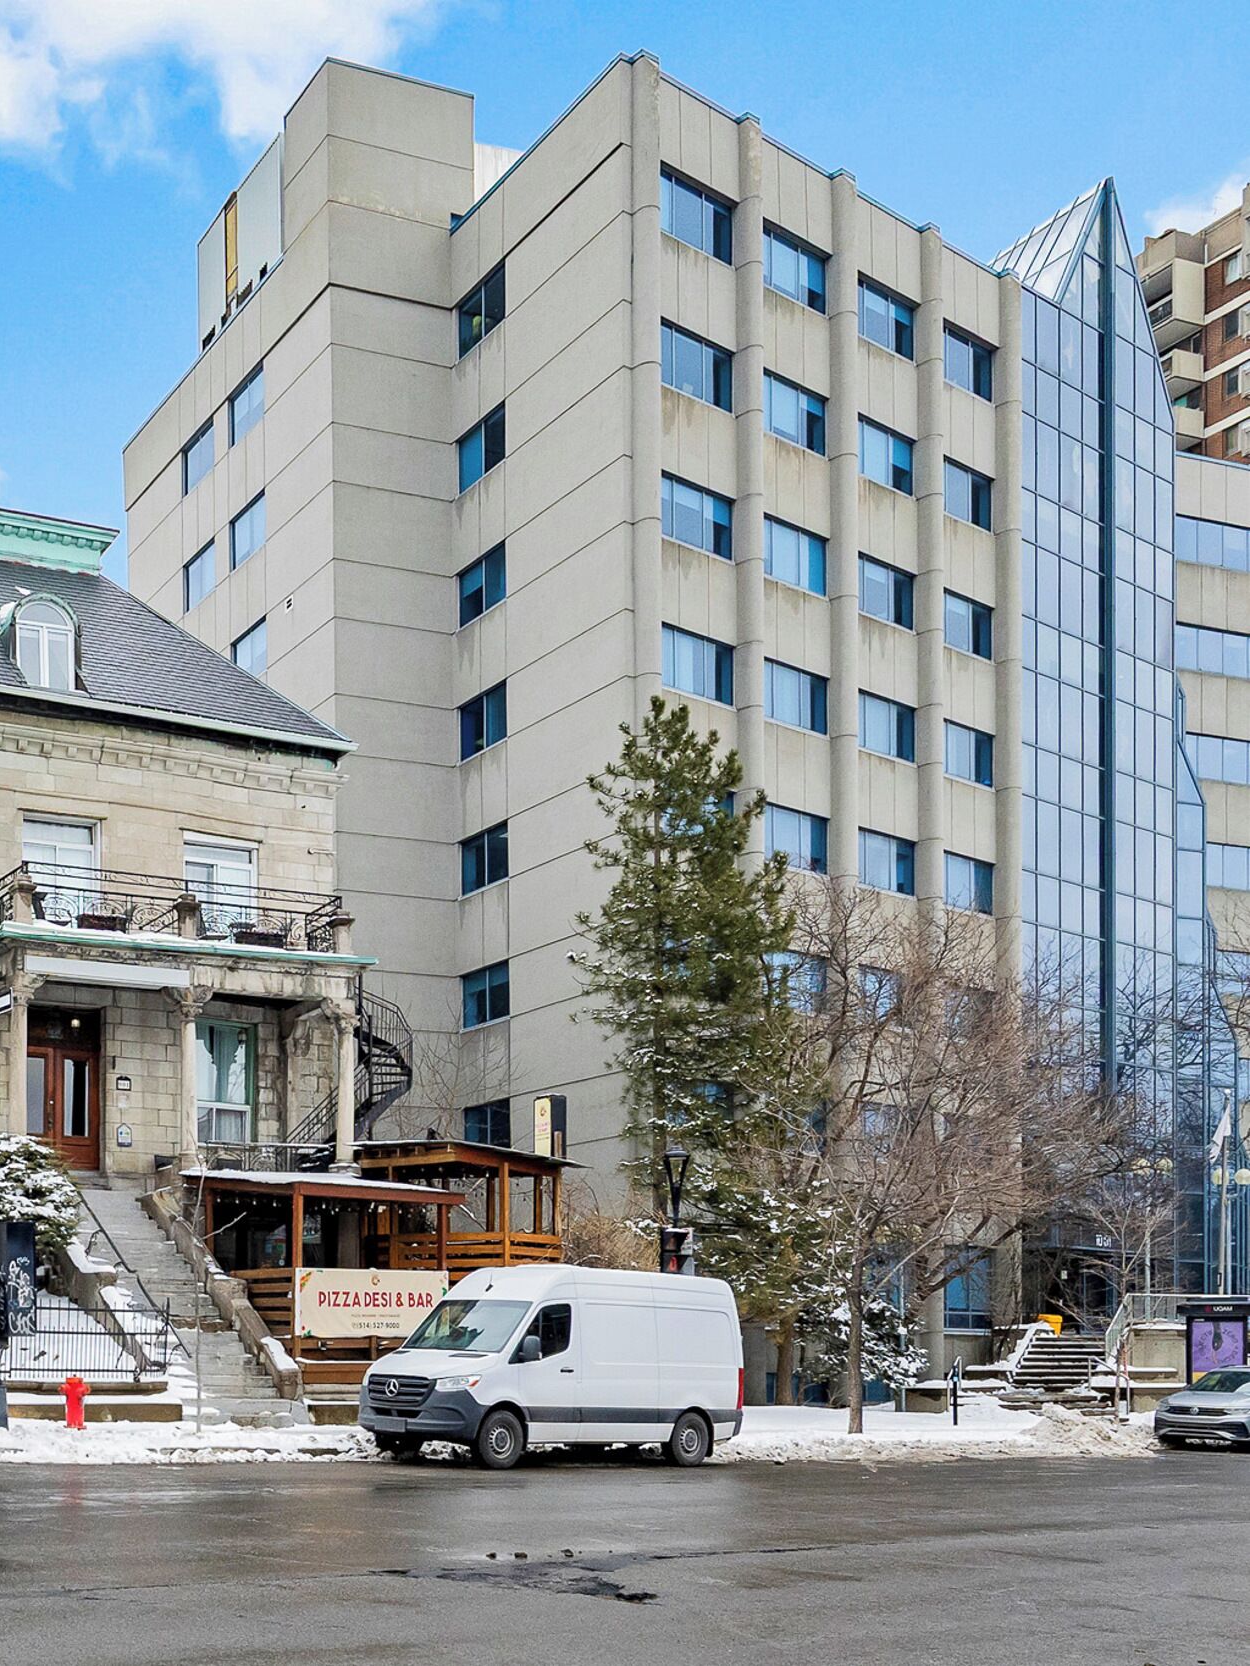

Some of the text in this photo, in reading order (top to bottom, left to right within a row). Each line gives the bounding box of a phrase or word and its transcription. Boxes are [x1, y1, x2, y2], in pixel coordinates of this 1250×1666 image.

[318, 1291, 434, 1308] PIZZA DESI & BAR
